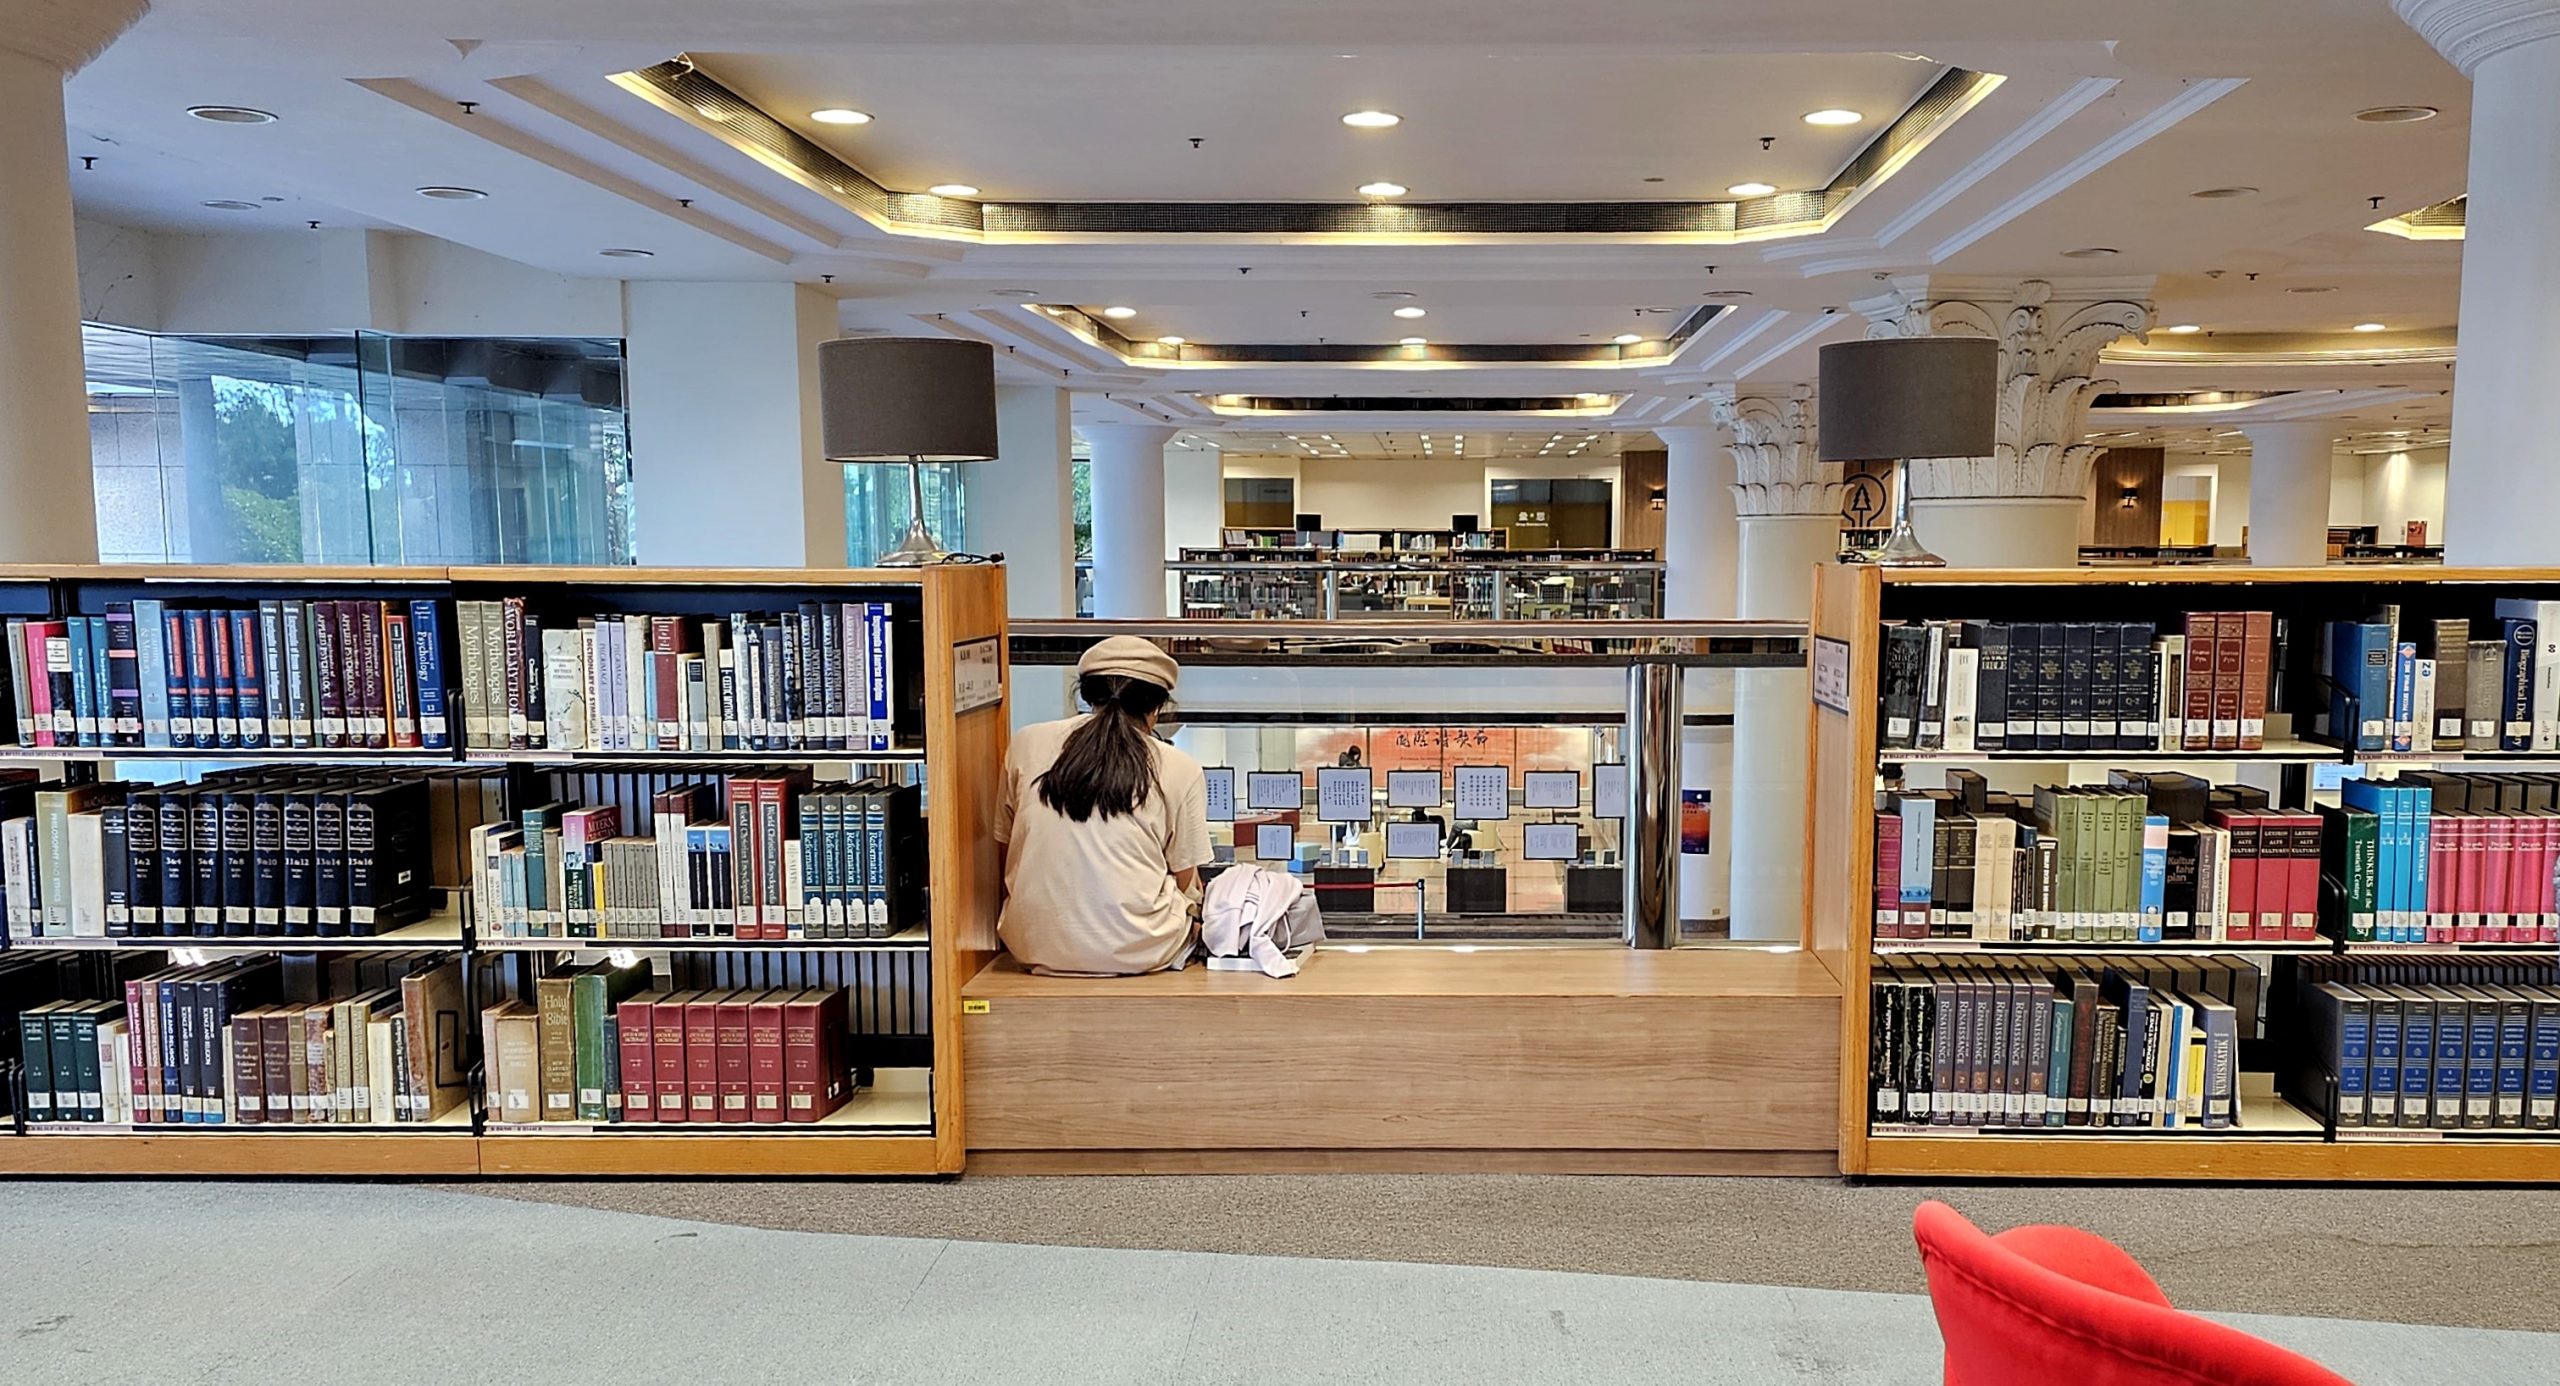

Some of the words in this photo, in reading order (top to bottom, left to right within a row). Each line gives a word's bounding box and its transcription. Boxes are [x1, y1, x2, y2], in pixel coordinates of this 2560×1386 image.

[151, 628, 160, 666] Learning
[317, 614, 326, 645] APPLIED
[342, 613, 352, 645] APPLIED
[361, 613, 371, 645] APPLIED
[505, 606, 517, 658] WORLD
[141, 640, 152, 674] Memory
[319, 647, 331, 698] PSYCHOLOGY
[345, 647, 356, 698] PSYCHOLOGY
[364, 647, 375, 698] PSYCHOLOGY
[416, 631, 429, 681] Psychology
[462, 625, 481, 704] Mythologies
[484, 626, 503, 704] Mythologies
[586, 638, 594, 685] DICTIONARY
[2516, 649, 2530, 700] Biographical
[589, 686, 595, 696] OF
[722, 676, 733, 695] CELTIC
[2512, 703, 2526, 747] Dictry
[50, 813, 60, 860] PHILOSOPHY
[739, 806, 748, 827] World
[767, 806, 775, 827] World
[767, 828, 777, 859] Christian
[804, 832, 813, 884] Reformation
[825, 832, 835, 884] Reformation
[846, 832, 856, 884] Reformation
[869, 832, 879, 884] Reformation
[2168, 856, 2195, 865] Kultur
[2354, 839, 2362, 872] Twentieth
[2366, 839, 2375, 888] THINKERS
[52, 877, 61, 902] ETHICS
[741, 860, 752, 904] Encyclopedia
[767, 860, 779, 904] Encyclopedia
[2167, 873, 2187, 883] plan
[2176, 865, 2194, 873] fahr
[2352, 874, 2361, 900] Century
[544, 995, 568, 1011] Holy
[545, 1011, 569, 1026] Bible
[2148, 1012, 2156, 1033] SCIENCE
[134, 1035, 143, 1067] RELIGION
[1938, 1001, 1950, 1064] RENAISSANCE
[1957, 1001, 1969, 1064] RENAISSANCE
[1975, 1001, 1987, 1065] RENAISSANCE
[1993, 1001, 2006, 1065] RENAISSANCE
[2012, 1002, 2025, 1066] RENAISSANCE
[2032, 1002, 2045, 1066] RENAISSANCE
[2215, 1039, 2228, 1095] NUMISMATIK
